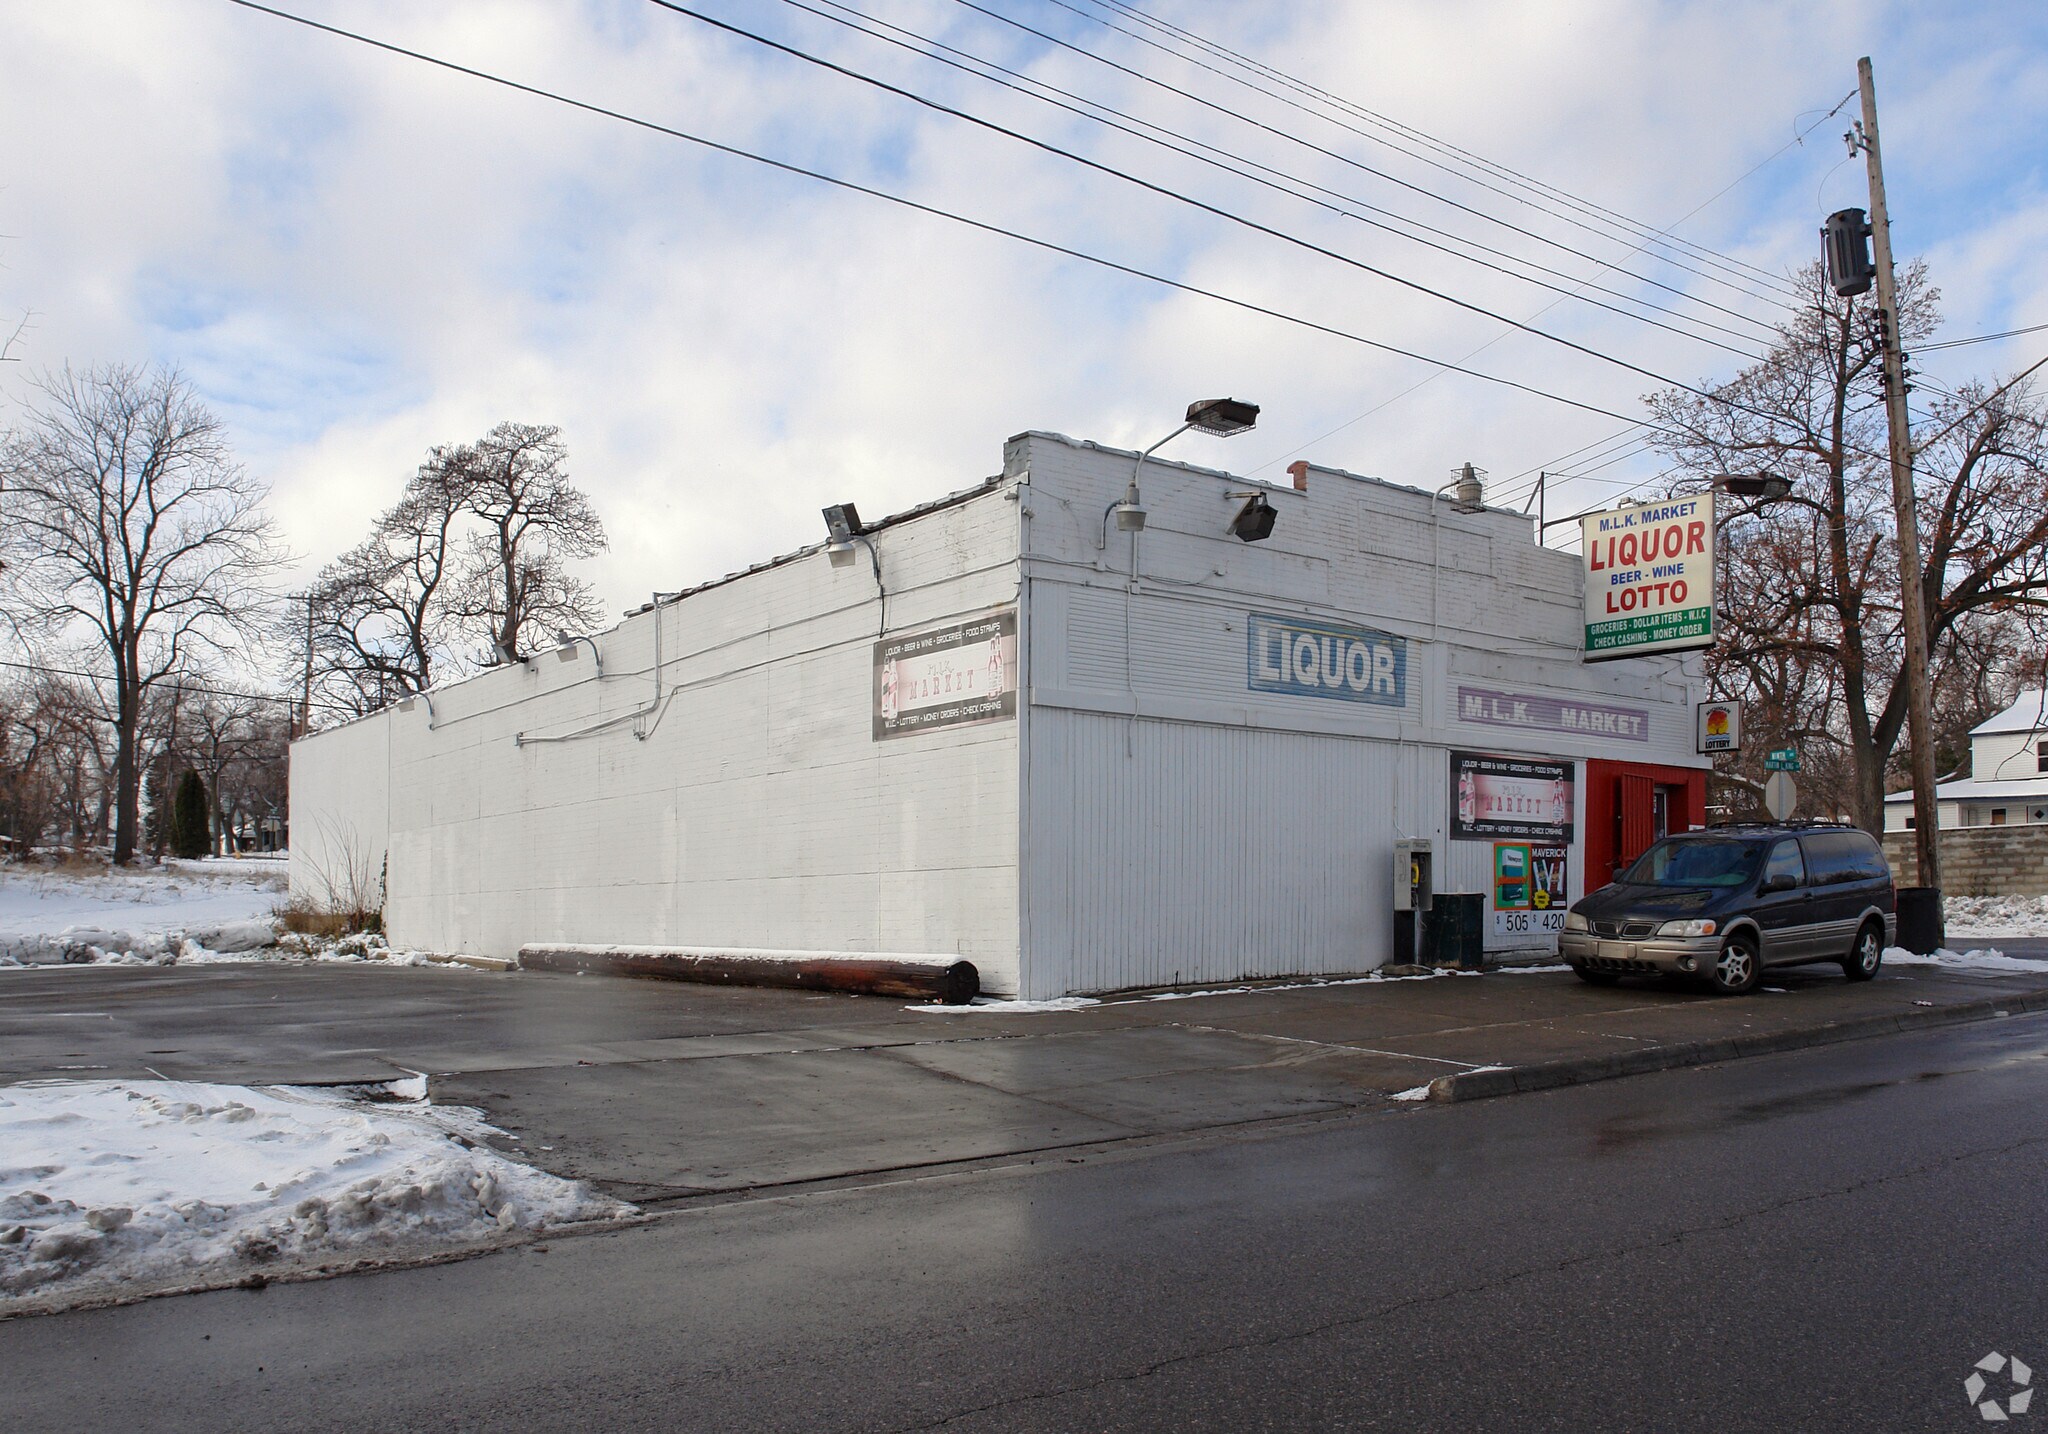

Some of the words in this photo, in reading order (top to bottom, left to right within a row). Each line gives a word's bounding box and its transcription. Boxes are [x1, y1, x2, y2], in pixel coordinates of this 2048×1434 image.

[1600, 516, 1637, 532] M.L.K.
[1641, 502, 1697, 524] MARKET
[1590, 520, 1706, 571] LIQUOR
[1611, 570, 1642, 586] BEER
[1652, 563, 1684, 579] WINE
[1606, 580, 1688, 614] LOTTO
[1591, 619, 1628, 636] GROCERIES
[1633, 615, 1660, 629] DOLLAR
[1661, 611, 1683, 625] ITEMS
[1594, 634, 1617, 649] CHECK
[1617, 631, 1648, 645] CASHING
[1653, 626, 1677, 640] MONEY
[1679, 623, 1703, 636] ORDER
[885, 645, 901, 657] LIQUOR
[904, 641, 915, 652] BEER
[921, 637, 933, 648] WINE
[936, 631, 962, 645] GROCERIES
[965, 627, 979, 638] FOOD
[979, 621, 1001, 635] STAMPS
[1258, 627, 1396, 695] LIQUOR
[909, 669, 974, 700] MARKET
[899, 715, 920, 726] LOTTERY
[923, 712, 940, 722] MONEY
[940, 708, 960, 719] ORDERS
[963, 704, 979, 715] CHECK
[979, 700, 1002, 712] CASHING
[1464, 695, 1535, 723] M.L.K.
[1561, 707, 1642, 736] MARKET
[1705, 740, 1730, 749] LOTTERY
[1486, 796, 1542, 814] MARKET
[1531, 848, 1566, 858] MAVERICK
[1496, 915, 1500, 925] $
[1533, 914, 1537, 923] $
